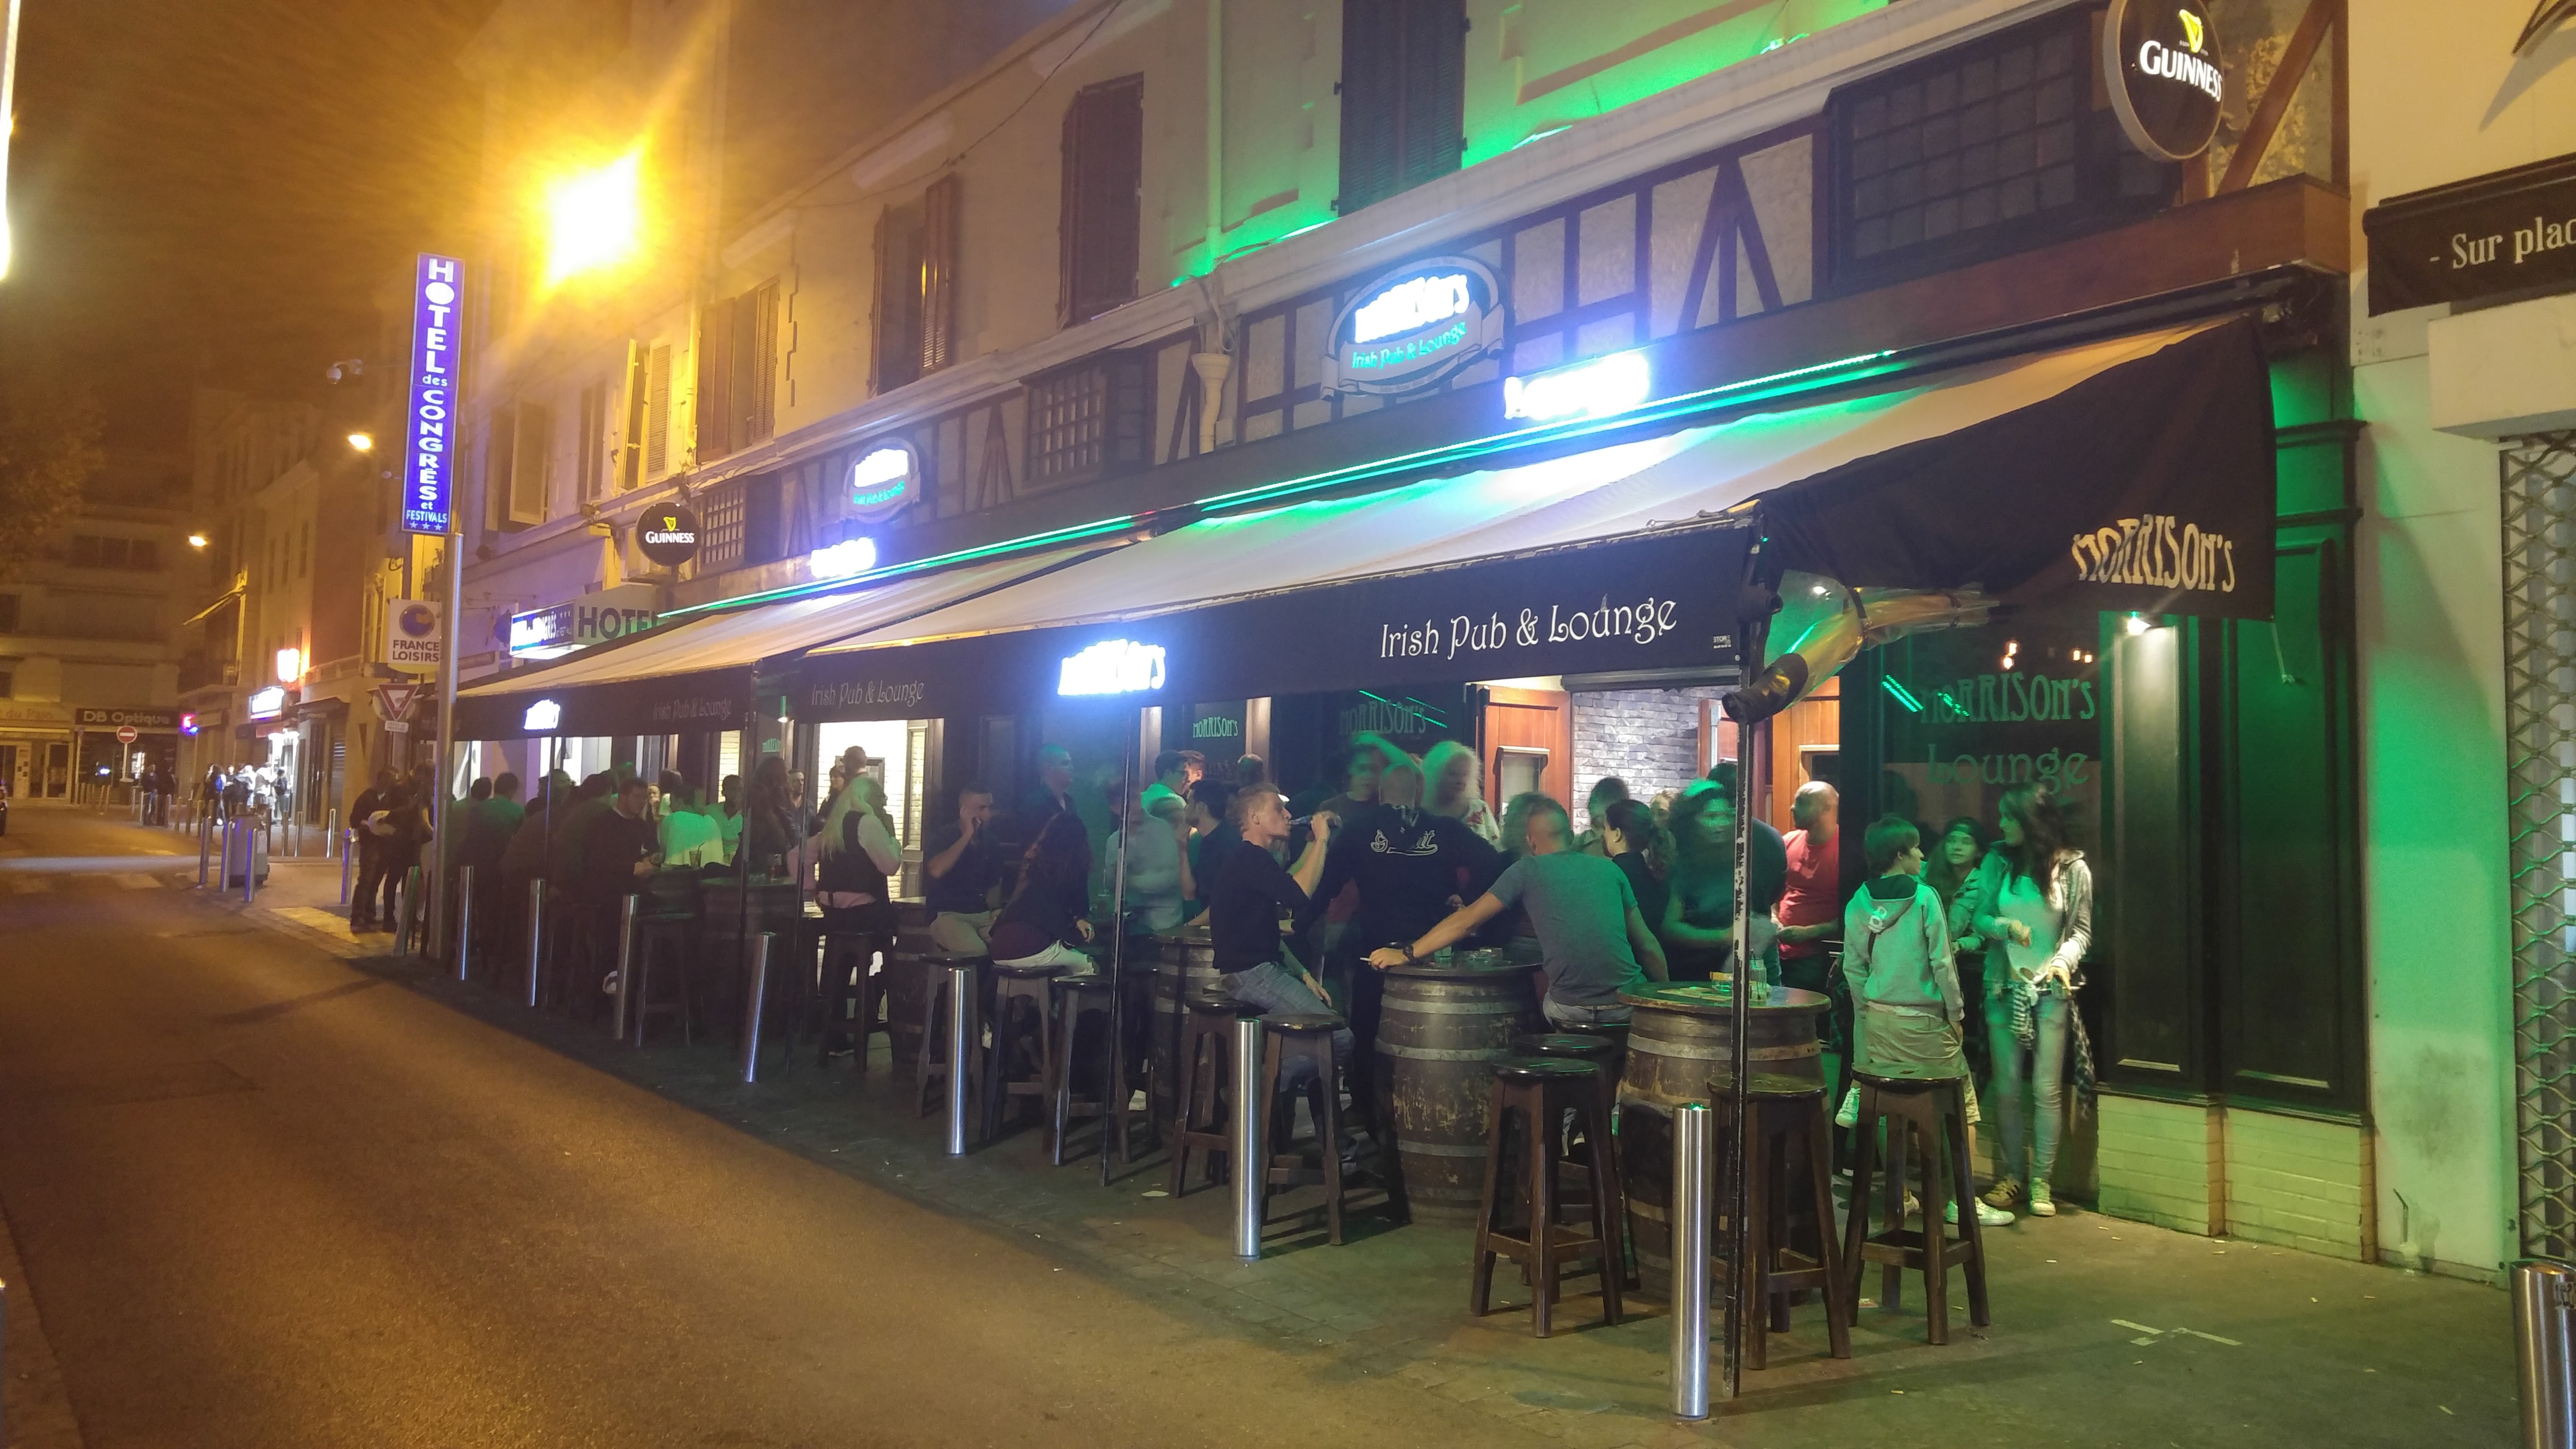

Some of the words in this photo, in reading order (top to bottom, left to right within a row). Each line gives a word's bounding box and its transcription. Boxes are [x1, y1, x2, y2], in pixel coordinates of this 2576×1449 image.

[2140, 40, 2223, 102] GUINNESS
[2452, 233, 2503, 269] Sur
[425, 258, 455, 373] HOTEL
[1352, 351, 1378, 368] Irish
[1379, 348, 1404, 370] Pub
[1419, 322, 1467, 356] Lounge
[422, 374, 448, 386] des
[406, 510, 448, 523] FESTIVALS
[420, 501, 433, 510] et
[645, 531, 695, 544] GUINNESS
[2071, 513, 2236, 593] MORRISON'S
[1380, 619, 1439, 658] Irish
[1447, 612, 1507, 660] Pub
[1516, 608, 1539, 646] &
[1548, 597, 1677, 644] Lounge
[392, 640, 440, 651] FRANCE
[392, 651, 440, 662] LOISIRS
[811, 683, 836, 706] Irish
[838, 681, 863, 709] Pub
[865, 680, 875, 704] &
[877, 680, 924, 708] Lounge
[1920, 671, 2095, 724] MORRISON'S
[83, 710, 108, 722] DB
[111, 711, 170, 726] Optique
[1192, 716, 1239, 738] MORRISON'S
[1926, 743, 2090, 794] Lounge
